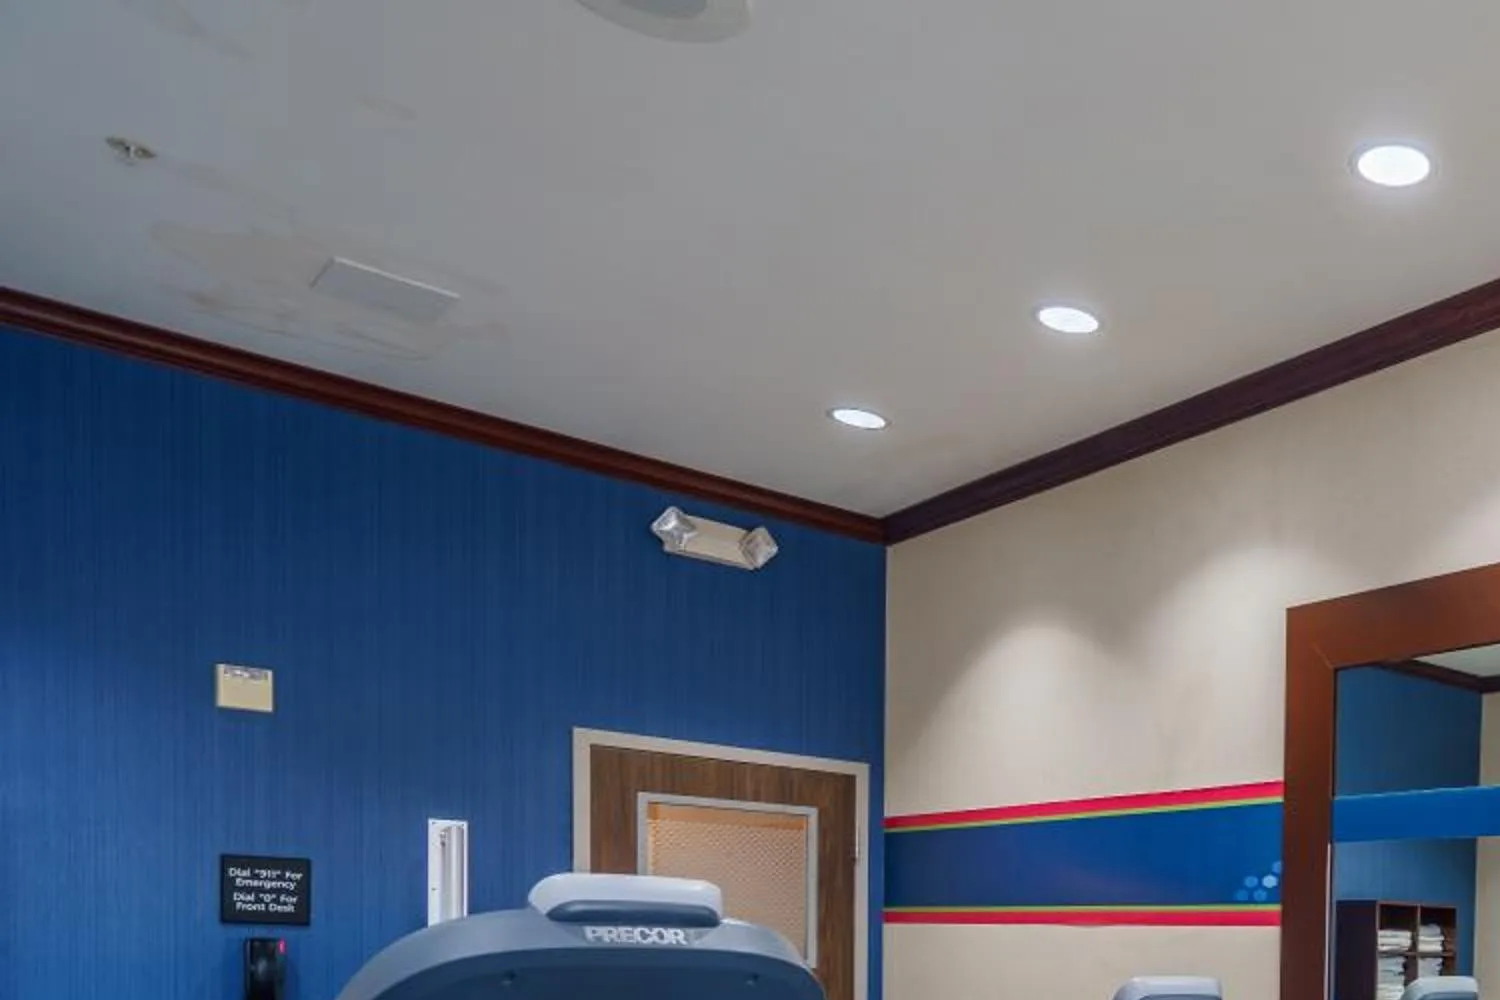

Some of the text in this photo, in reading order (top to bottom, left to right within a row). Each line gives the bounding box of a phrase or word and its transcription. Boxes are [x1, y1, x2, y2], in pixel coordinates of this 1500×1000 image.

[229, 868, 250, 878] Dial
[285, 871, 303, 880] For
[235, 878, 297, 890] Emergency
[233, 892, 255, 902] Dial
[280, 894, 297, 904] For
[235, 902, 296, 913] Front Desk
[583, 926, 688, 945] PRECOR
